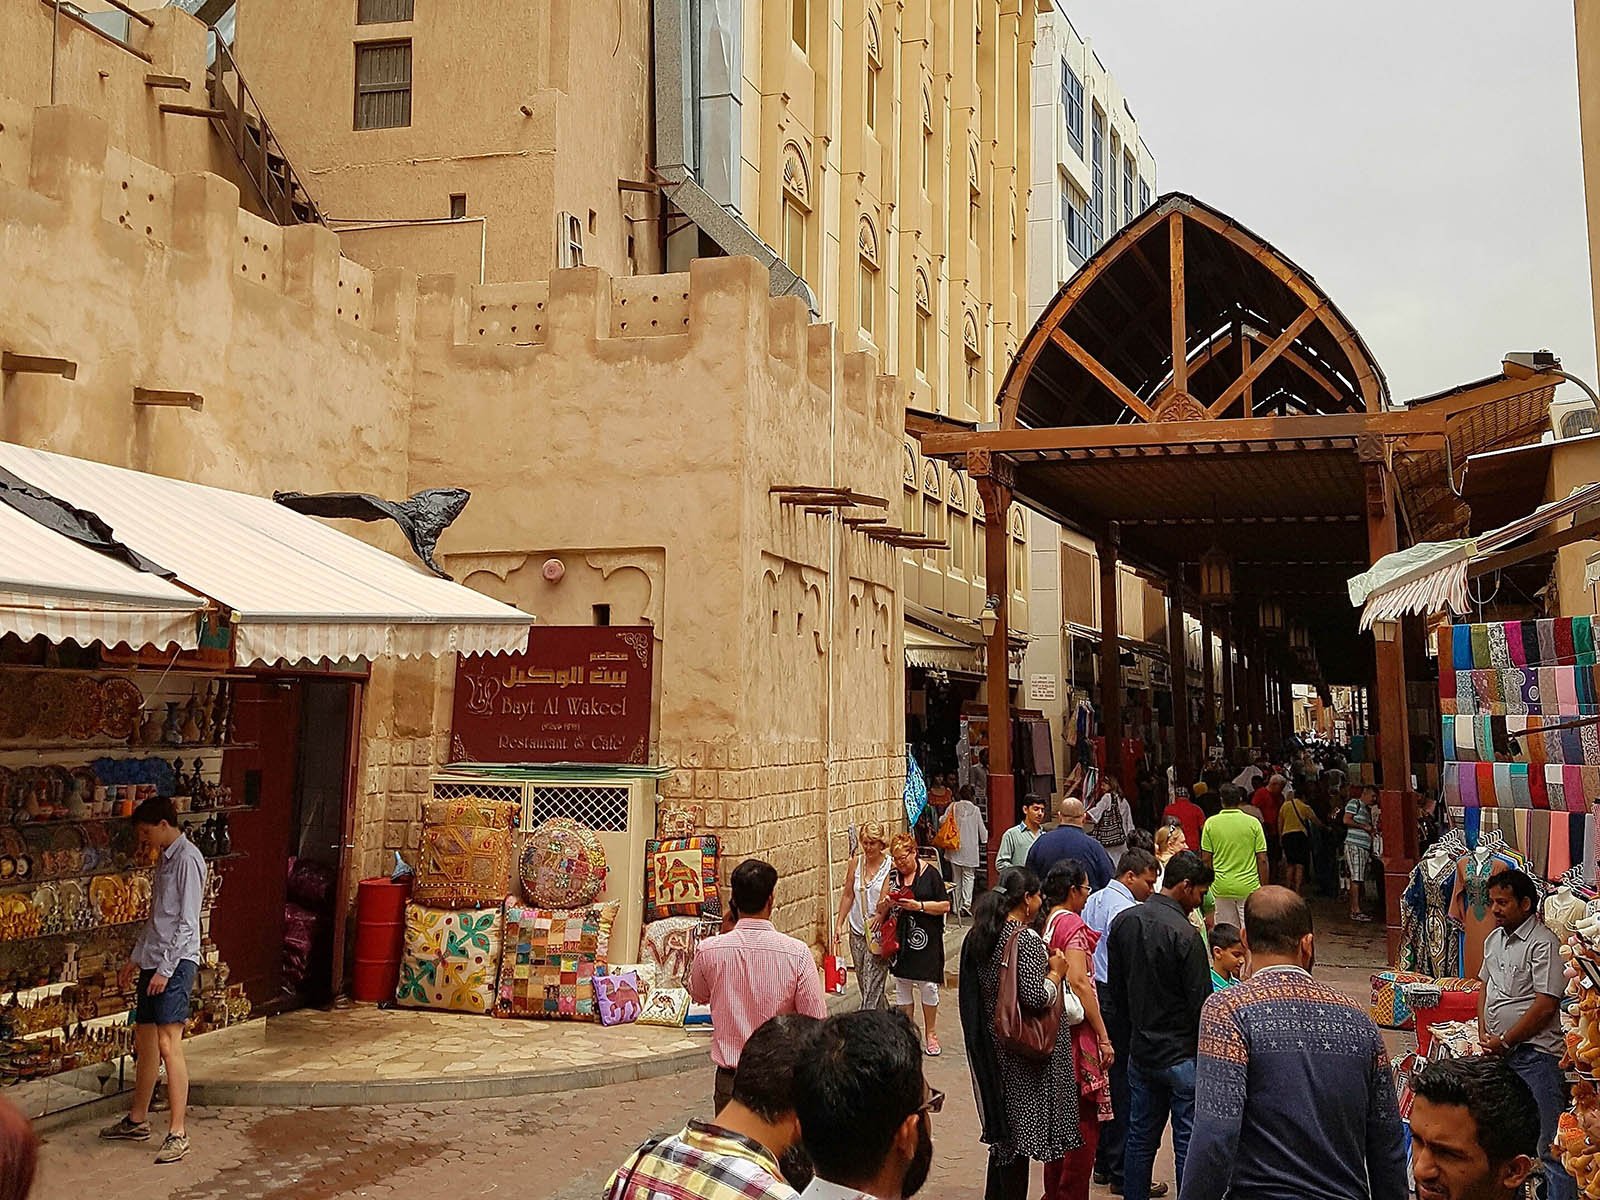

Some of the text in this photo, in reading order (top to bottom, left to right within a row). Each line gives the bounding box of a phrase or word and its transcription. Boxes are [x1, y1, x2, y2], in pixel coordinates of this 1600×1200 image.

[501, 665, 627, 688] بيت الوكيل
[501, 695, 627, 720] Bayt Al Wakeel
[498, 735, 569, 749] Restaurant
[573, 735, 585, 750] &
